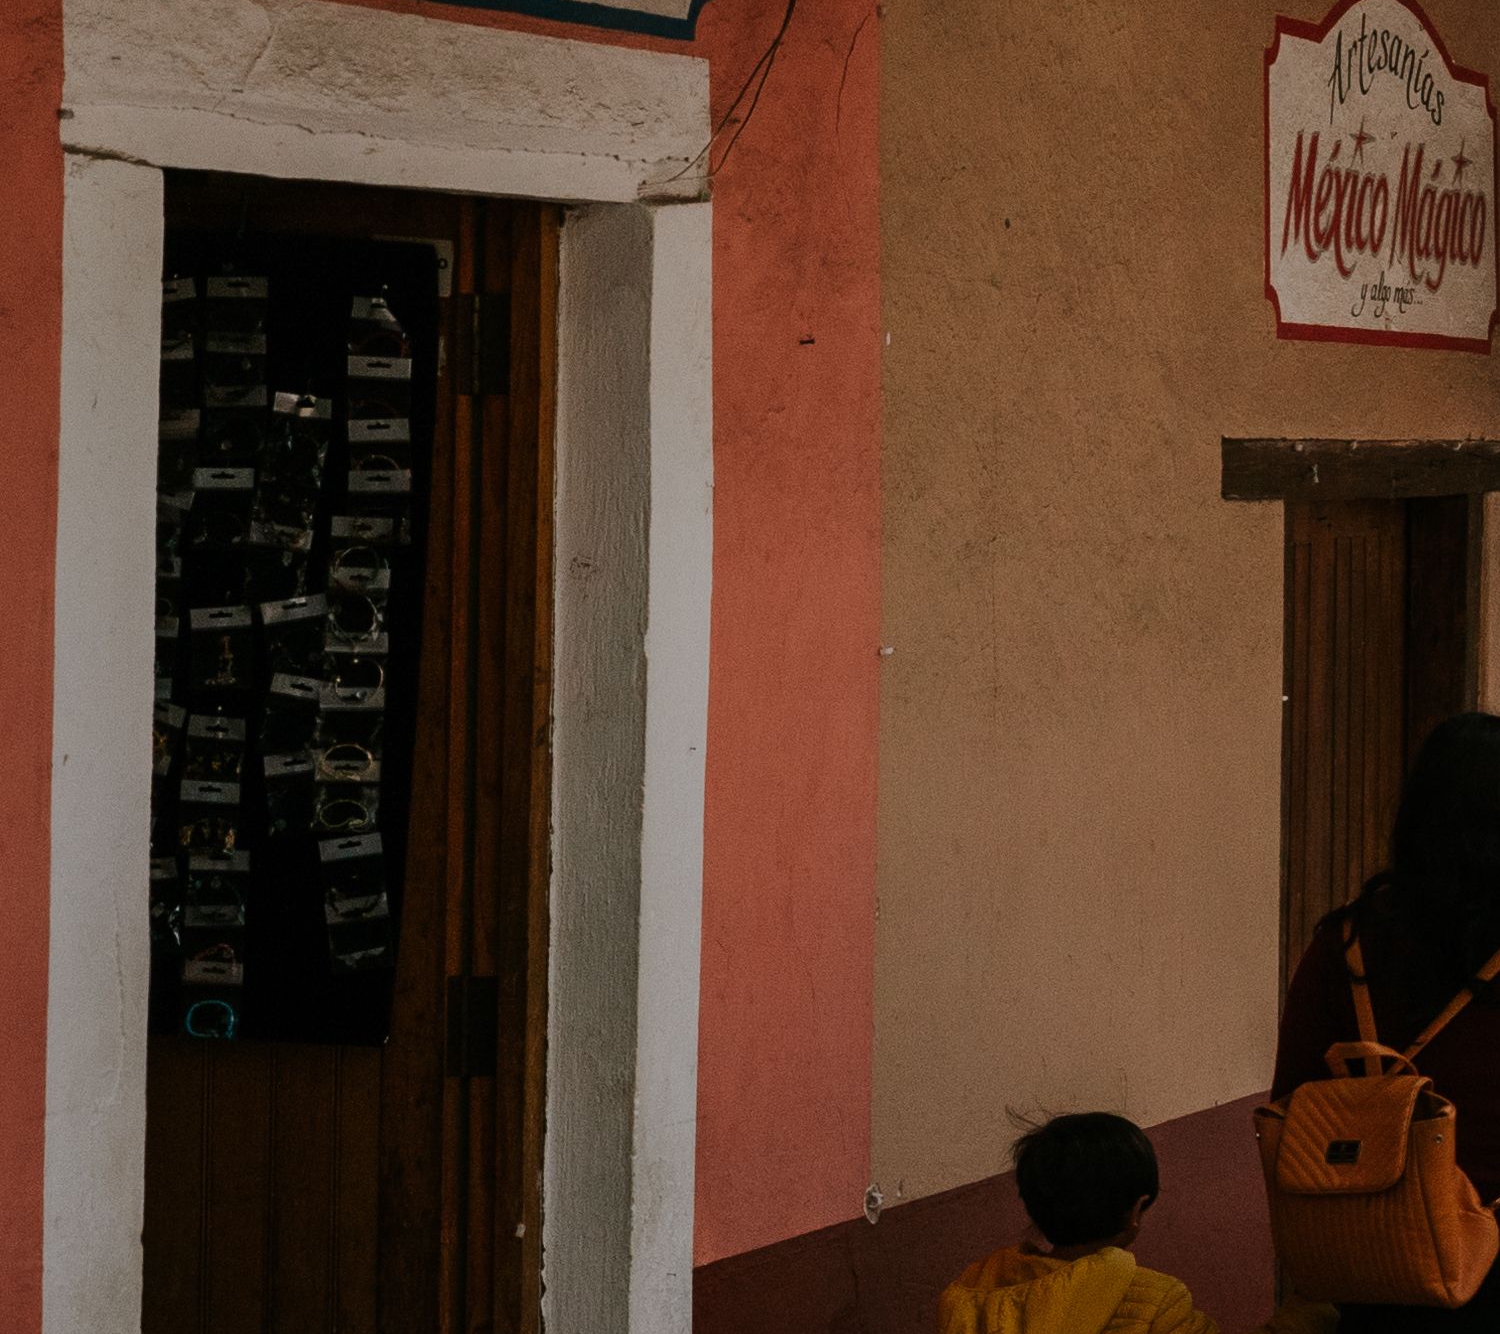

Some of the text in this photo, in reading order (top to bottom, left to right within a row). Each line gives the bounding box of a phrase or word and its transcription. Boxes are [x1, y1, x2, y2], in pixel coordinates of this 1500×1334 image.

[1329, 13, 1445, 125] Artesanías
[1281, 130, 1488, 293] México Mágico
[1351, 283, 1369, 317] y
[1371, 271, 1392, 318] algo
